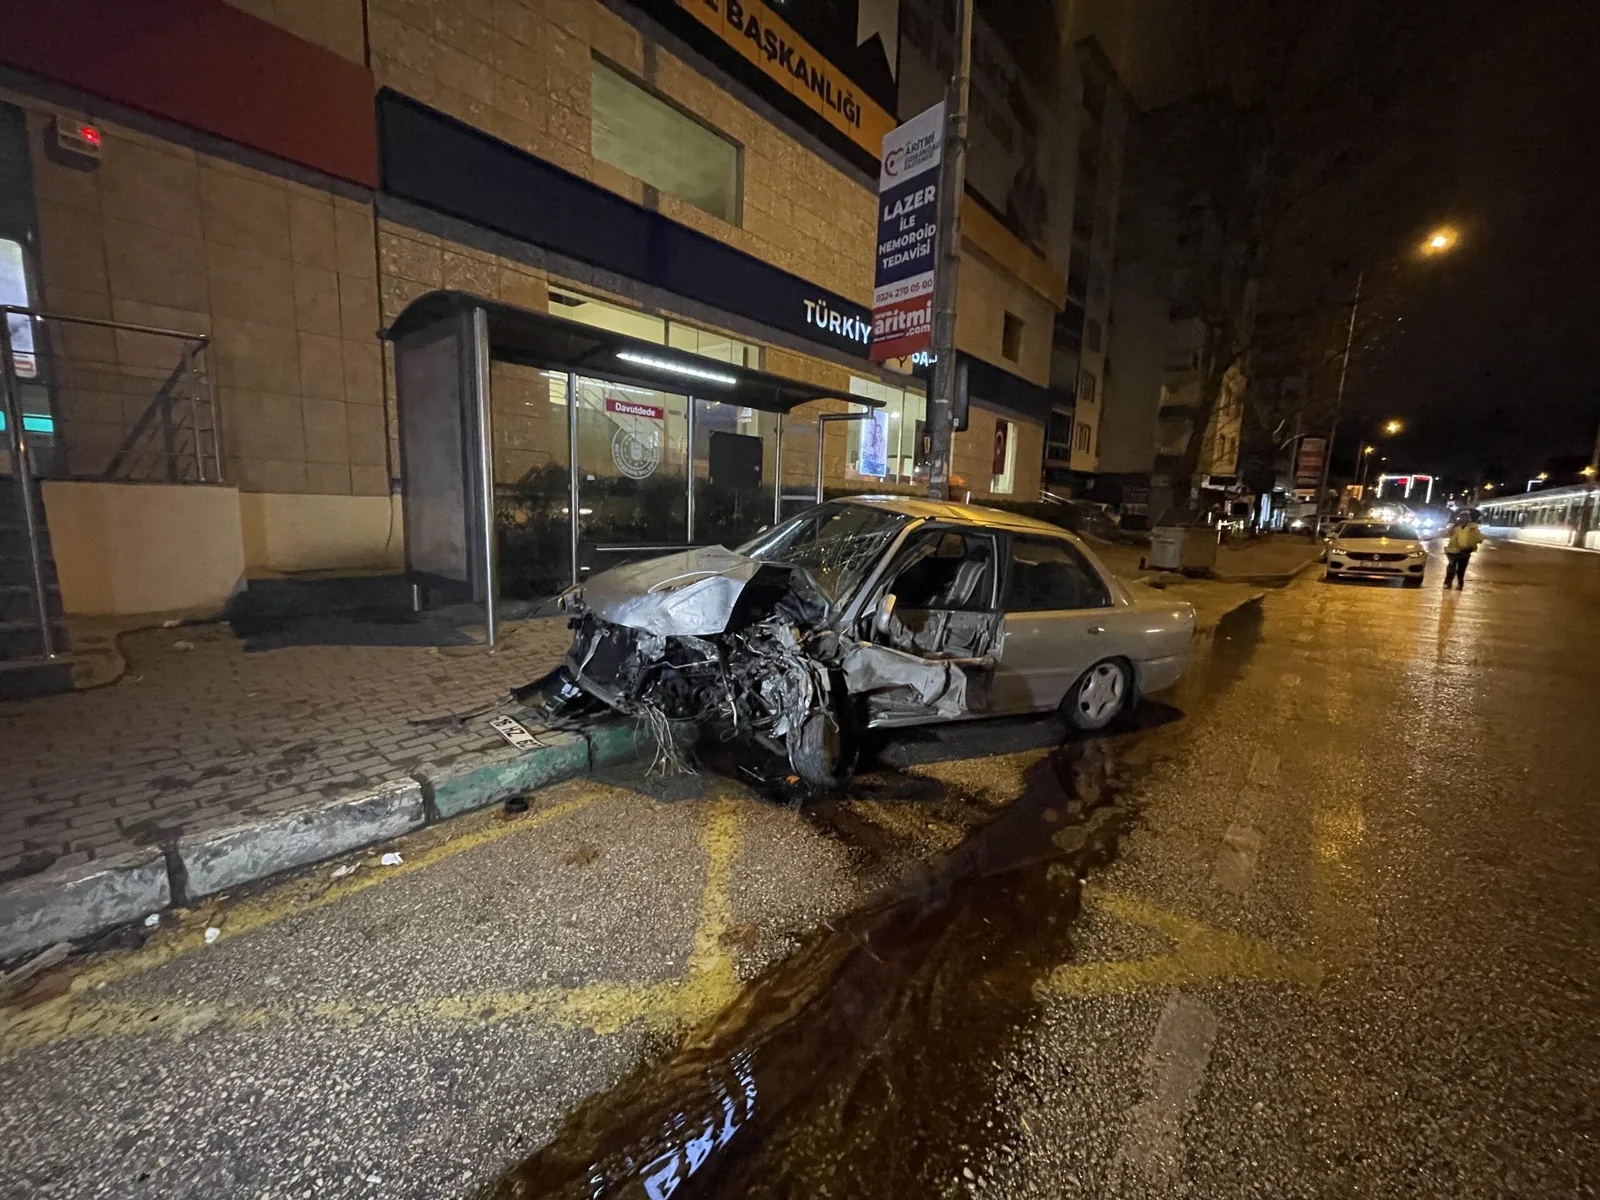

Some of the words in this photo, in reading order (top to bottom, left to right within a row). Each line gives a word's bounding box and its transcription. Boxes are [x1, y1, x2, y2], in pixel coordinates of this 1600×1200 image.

[727, 0, 860, 128] BAŞKANLIĞI
[883, 185, 936, 221] LAZER
[899, 215, 916, 231] İLE
[879, 223, 936, 255] HEMOROİD
[882, 239, 930, 269] TEDAVİSİ
[876, 290, 894, 302] 0224
[895, 286, 909, 298] 270
[910, 282, 920, 293] 05
[922, 279, 933, 289] 00
[804, 299, 872, 345] TÜRKİY
[875, 300, 932, 335] aritmi
[906, 324, 931, 337] .com
[615, 402, 656, 417] Davutdede
